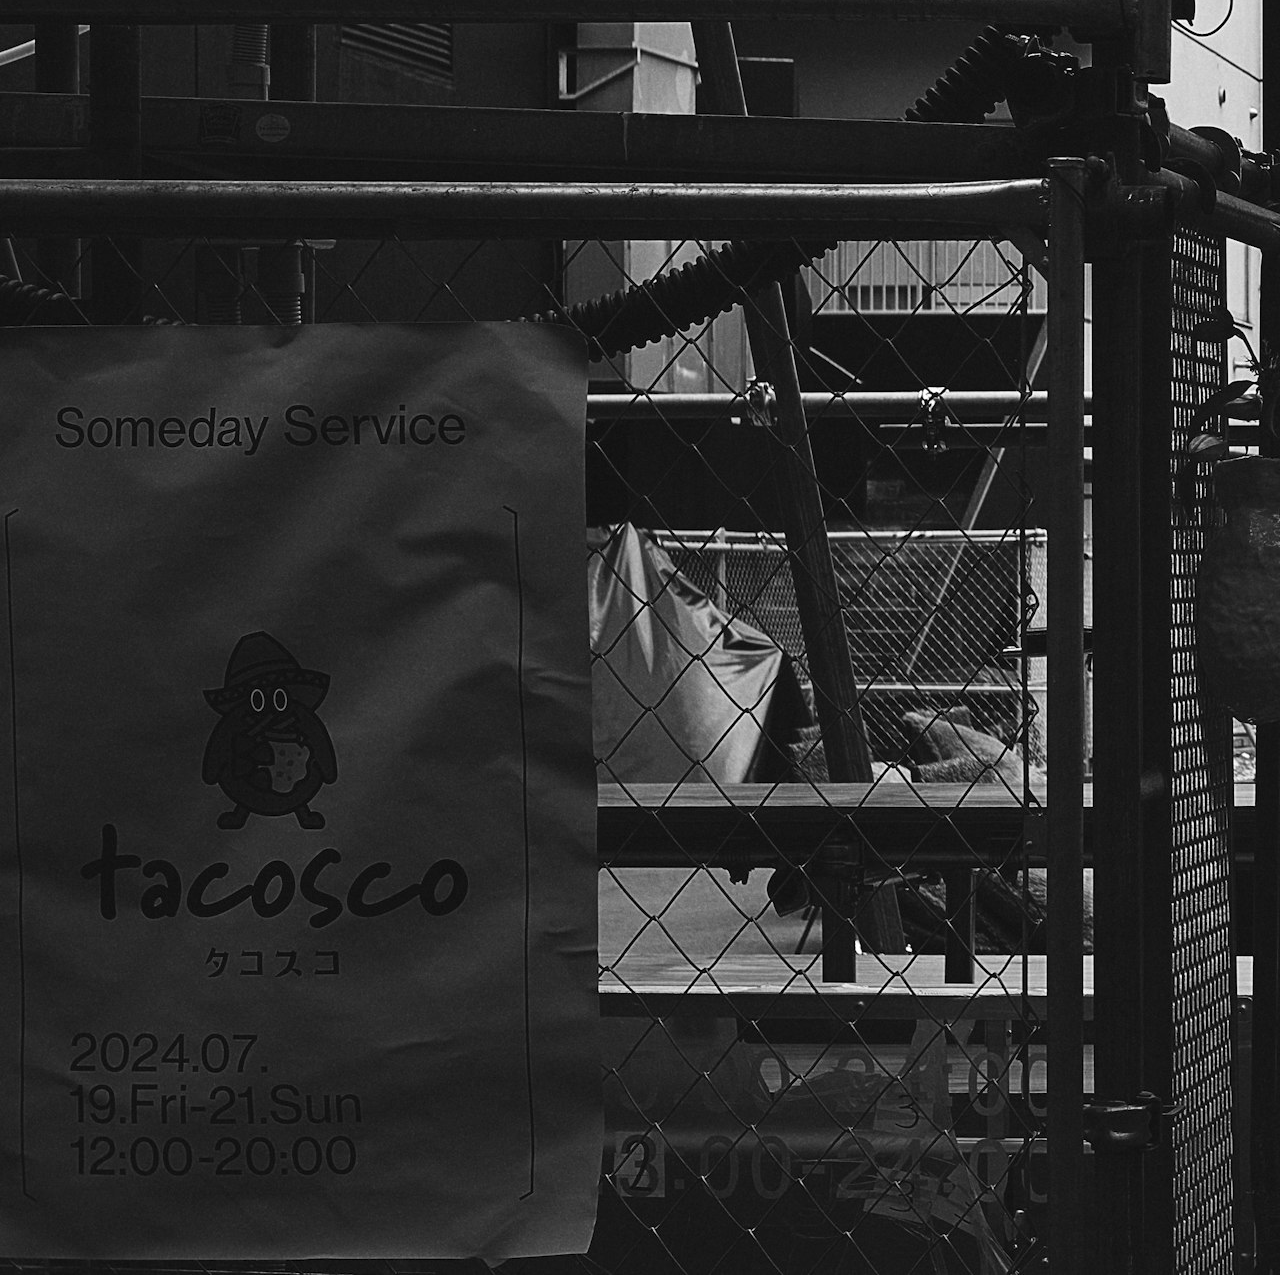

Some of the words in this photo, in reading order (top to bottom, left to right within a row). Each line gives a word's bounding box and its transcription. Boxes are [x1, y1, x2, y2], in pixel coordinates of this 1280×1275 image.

[55, 405, 270, 456] Someday
[283, 402, 467, 447] Service
[81, 822, 470, 929] tacosco
[205, 946, 342, 979] タコスコ
[70, 1031, 269, 1074] 2024.07.
[70, 1083, 363, 1127] 19.Fri-21.Sun
[70, 1135, 358, 1178] 12:00-20:00
